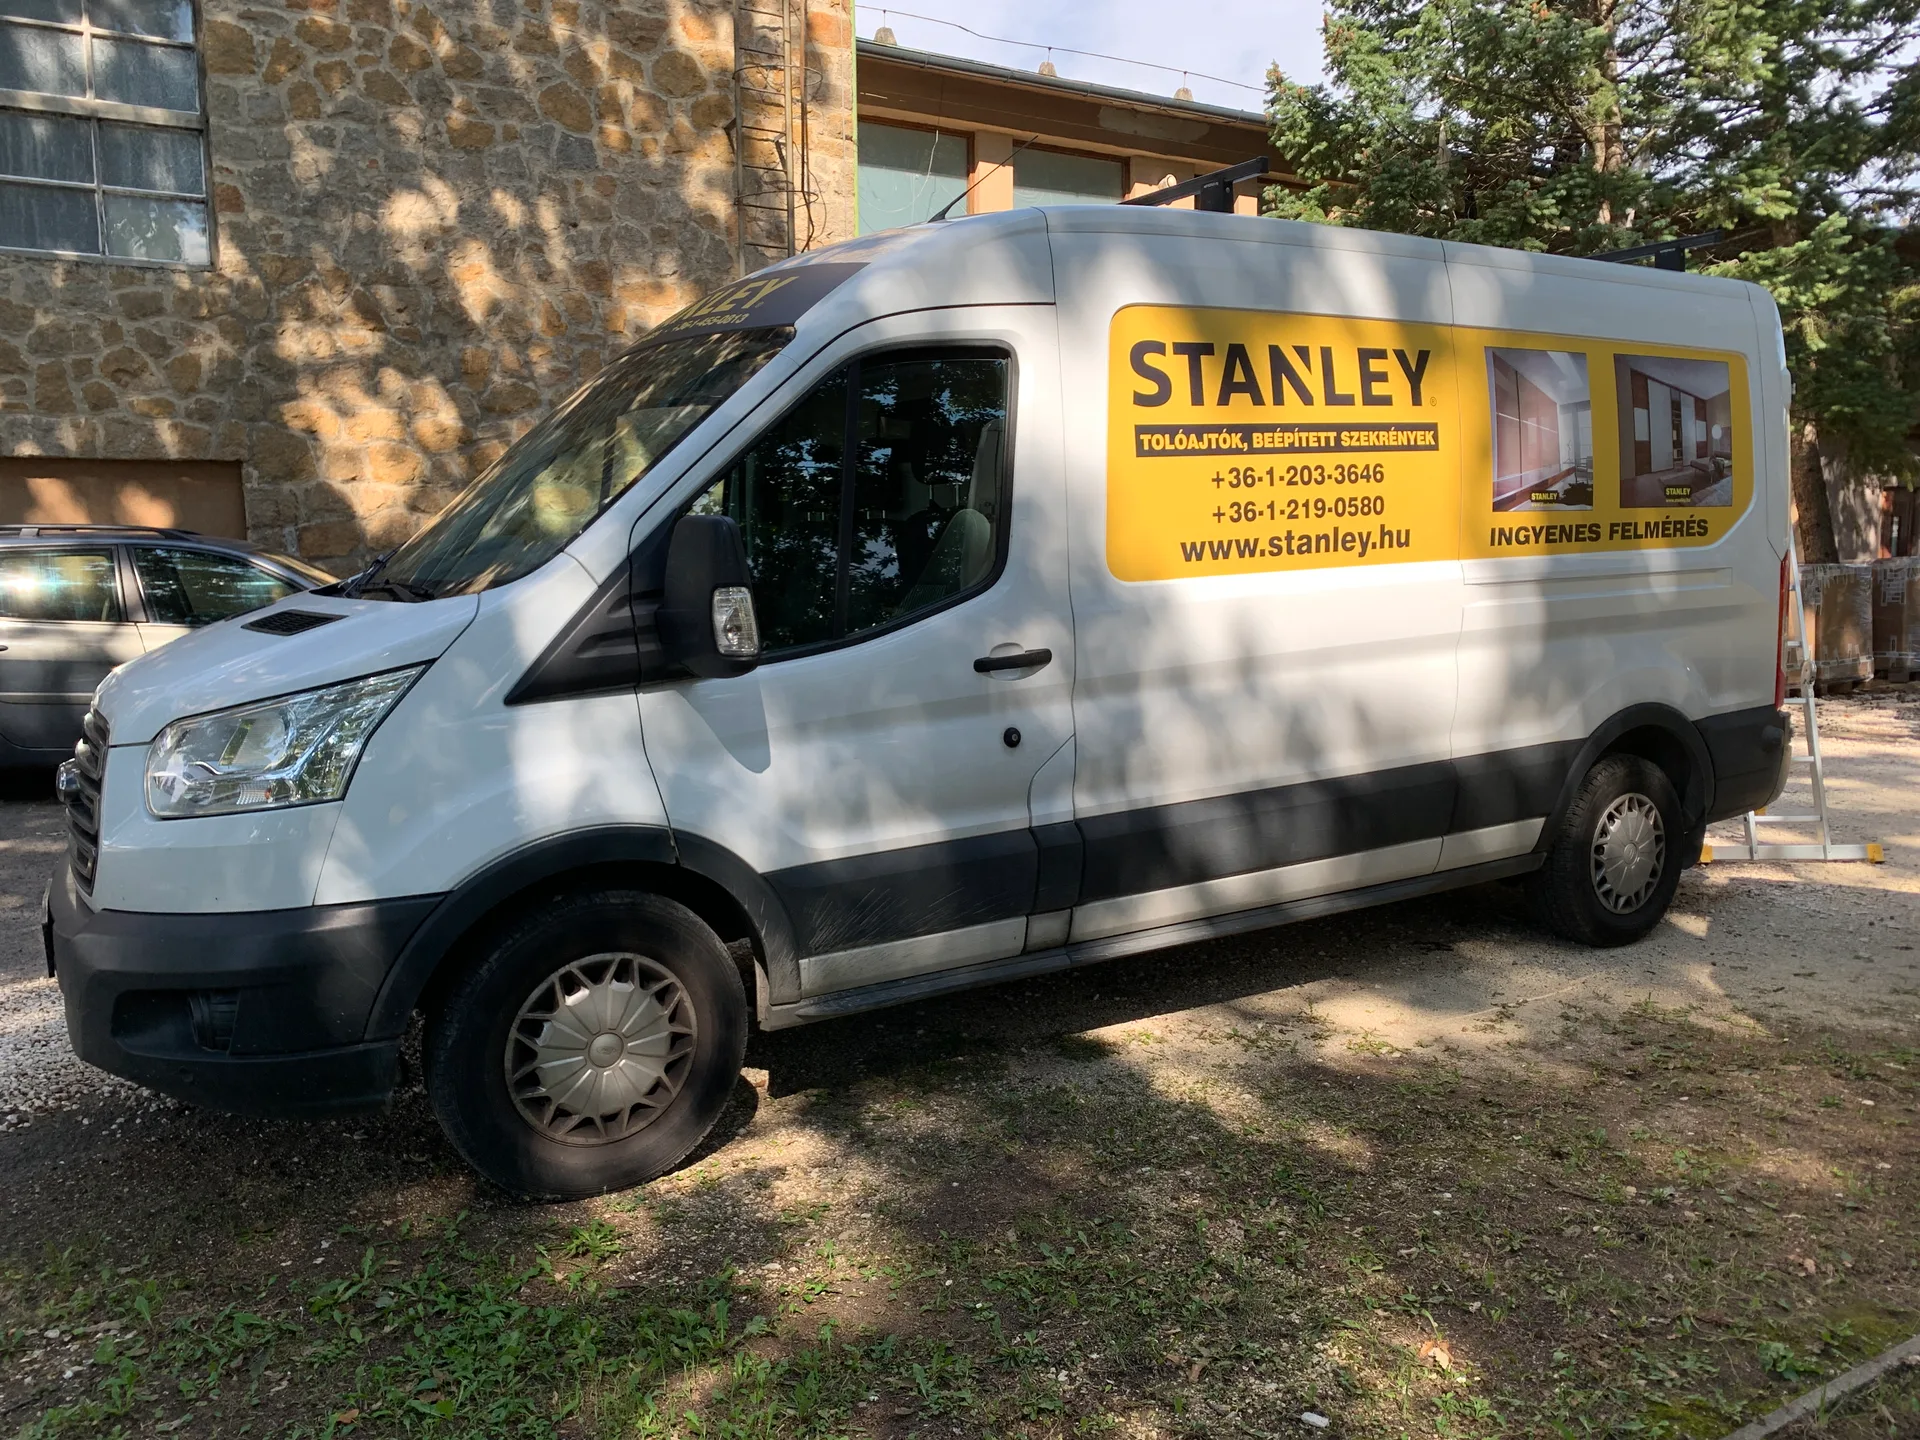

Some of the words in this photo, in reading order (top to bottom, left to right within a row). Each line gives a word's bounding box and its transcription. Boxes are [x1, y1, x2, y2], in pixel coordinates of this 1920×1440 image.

[1129, 339, 1431, 407] STANLEY
[1139, 429, 1248, 452] TOLÓAJTÓK,
[1252, 427, 1337, 448] BEÉPÍTETT
[1340, 427, 1436, 447] SZEKRÉNYEK
[1211, 463, 1385, 489] +36-1-203-3646
[1531, 492, 1558, 501] STANLEY
[1665, 487, 1691, 496] STANLEY
[1212, 495, 1385, 524] +36-1-219-0580
[1180, 524, 1411, 562] www.stanley.hu
[1489, 523, 1602, 546] INGYENES
[1608, 514, 1709, 541] FELMÉRÉS
